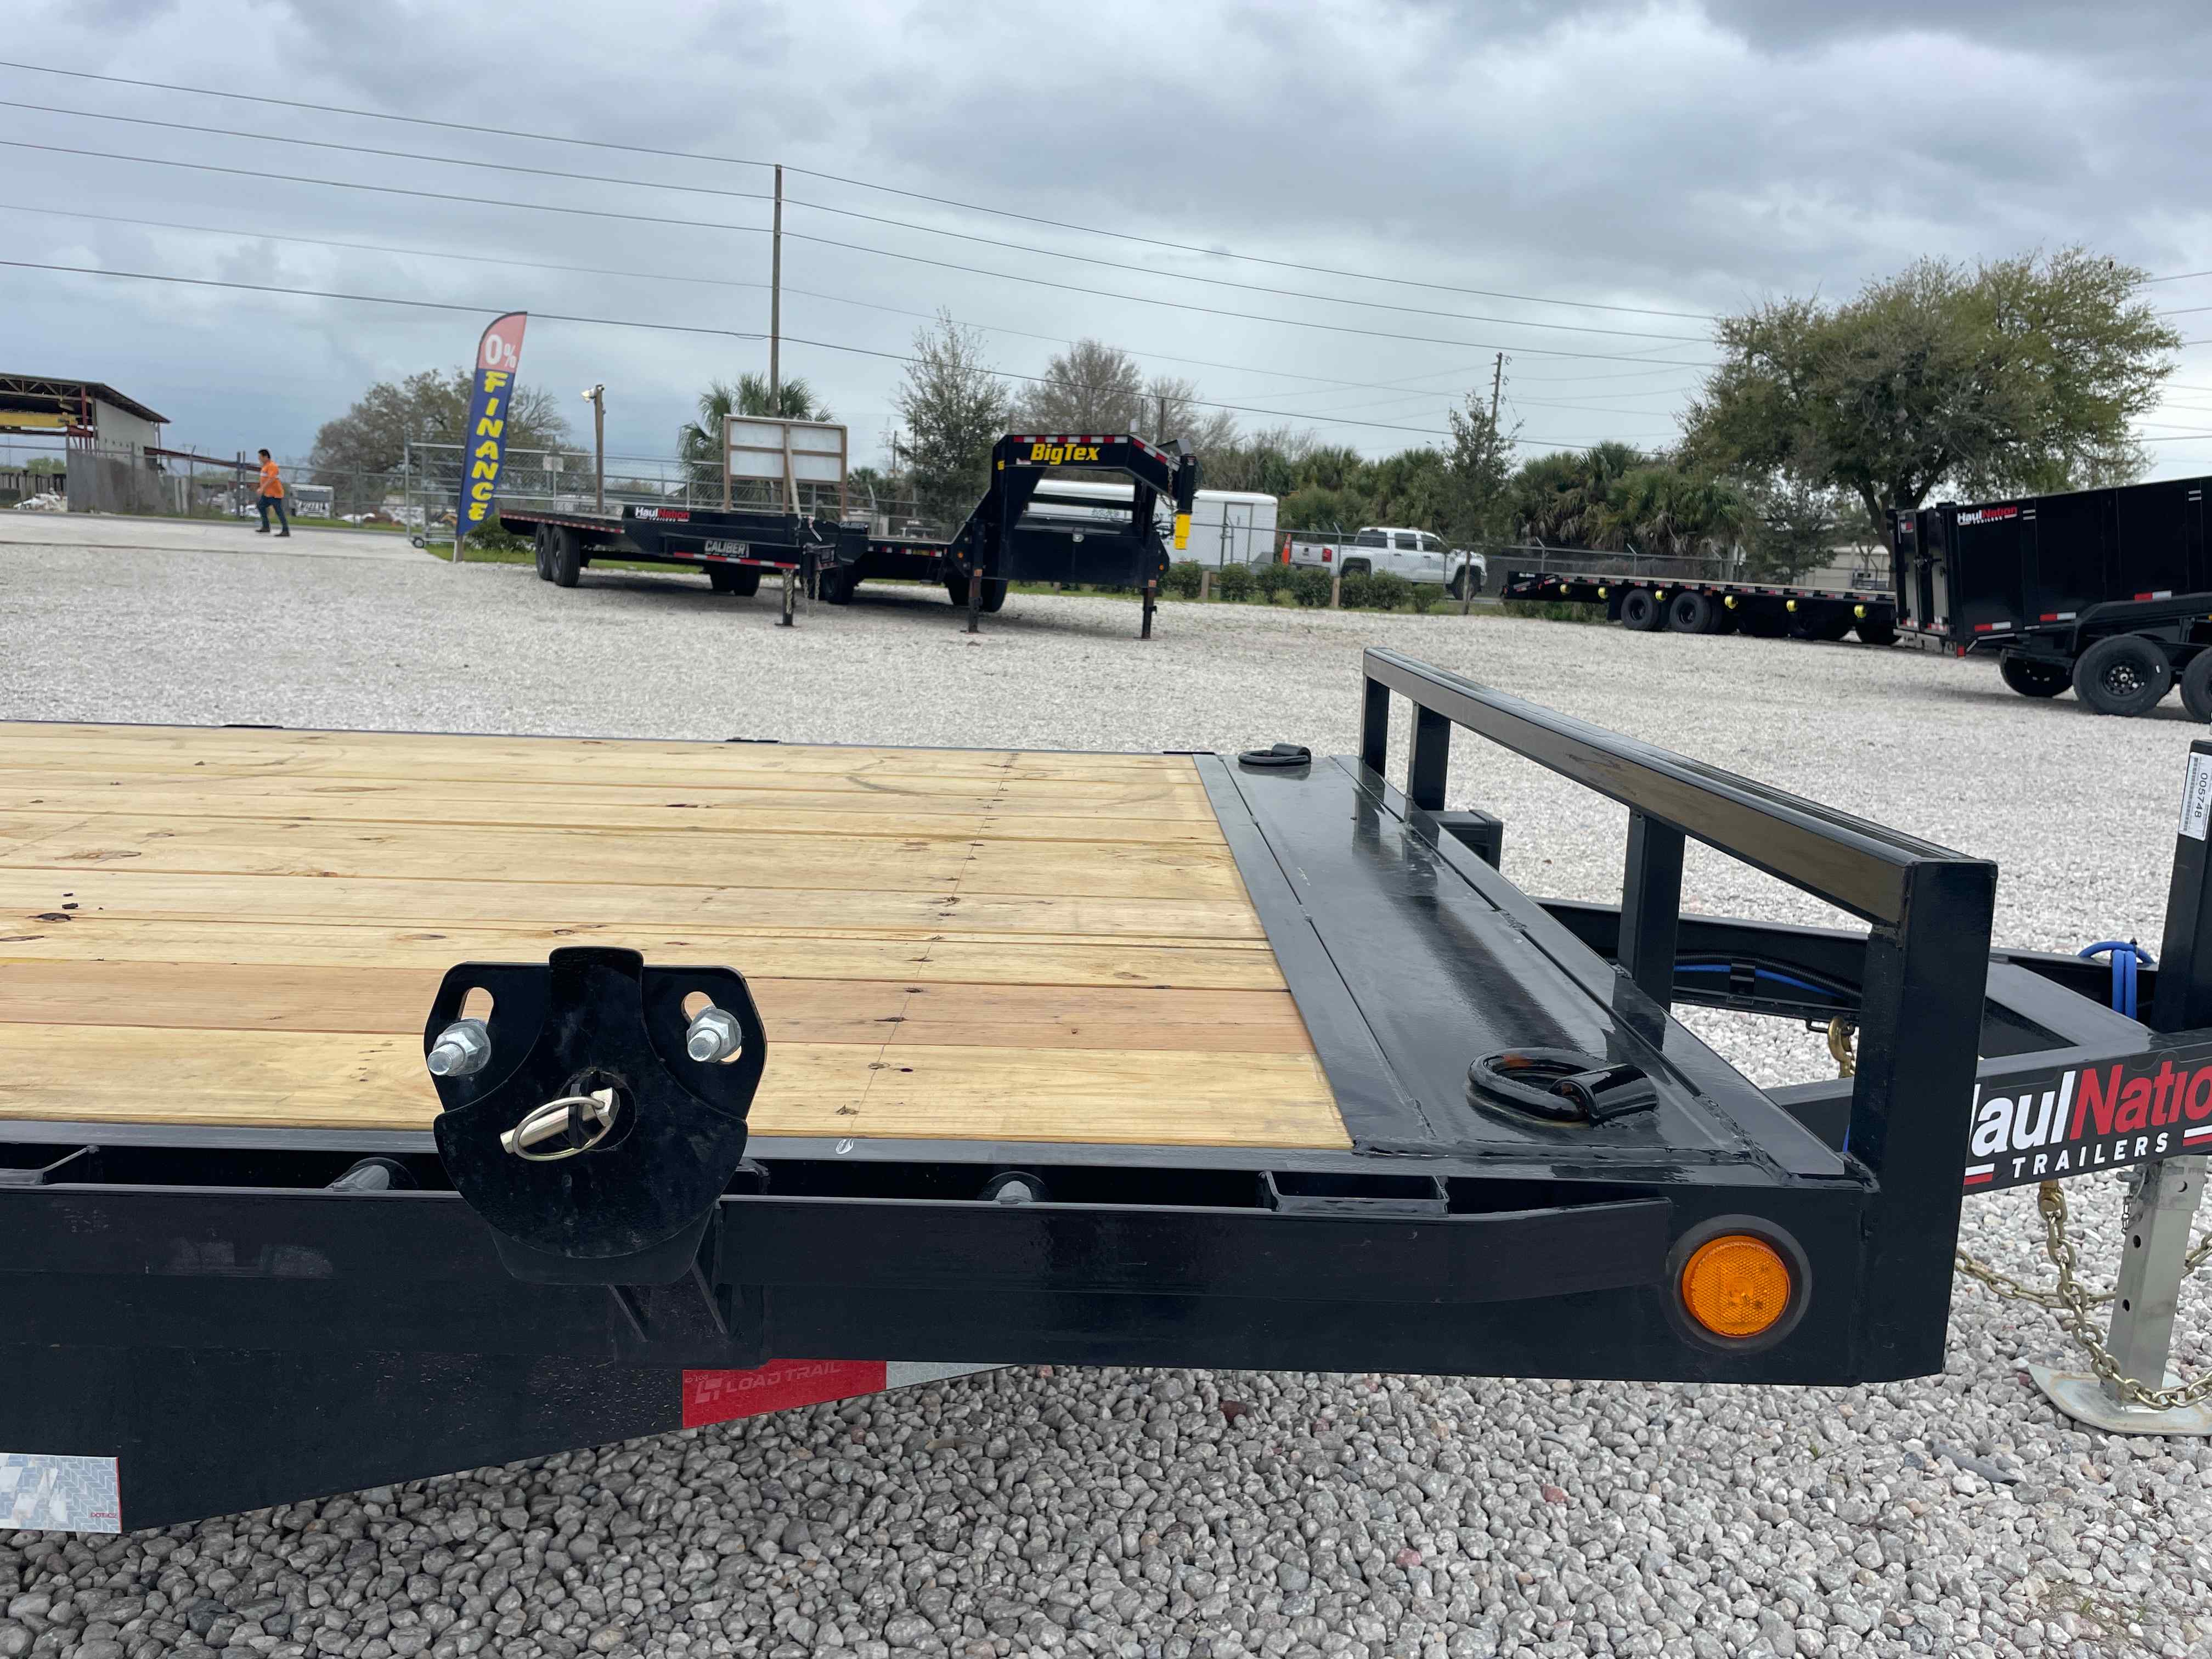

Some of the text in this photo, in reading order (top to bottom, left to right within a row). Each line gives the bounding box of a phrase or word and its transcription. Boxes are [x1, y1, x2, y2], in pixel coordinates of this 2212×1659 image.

[485, 334, 517, 369] 0%
[468, 370, 509, 521] FINANCE
[1030, 443, 1101, 465] BigTex
[704, 540, 747, 555] CALIBER
[2194, 772, 2208, 818] 005748
[1970, 1060, 2212, 1158] aulNatio
[2012, 1132, 2169, 1179] TRAILERS
